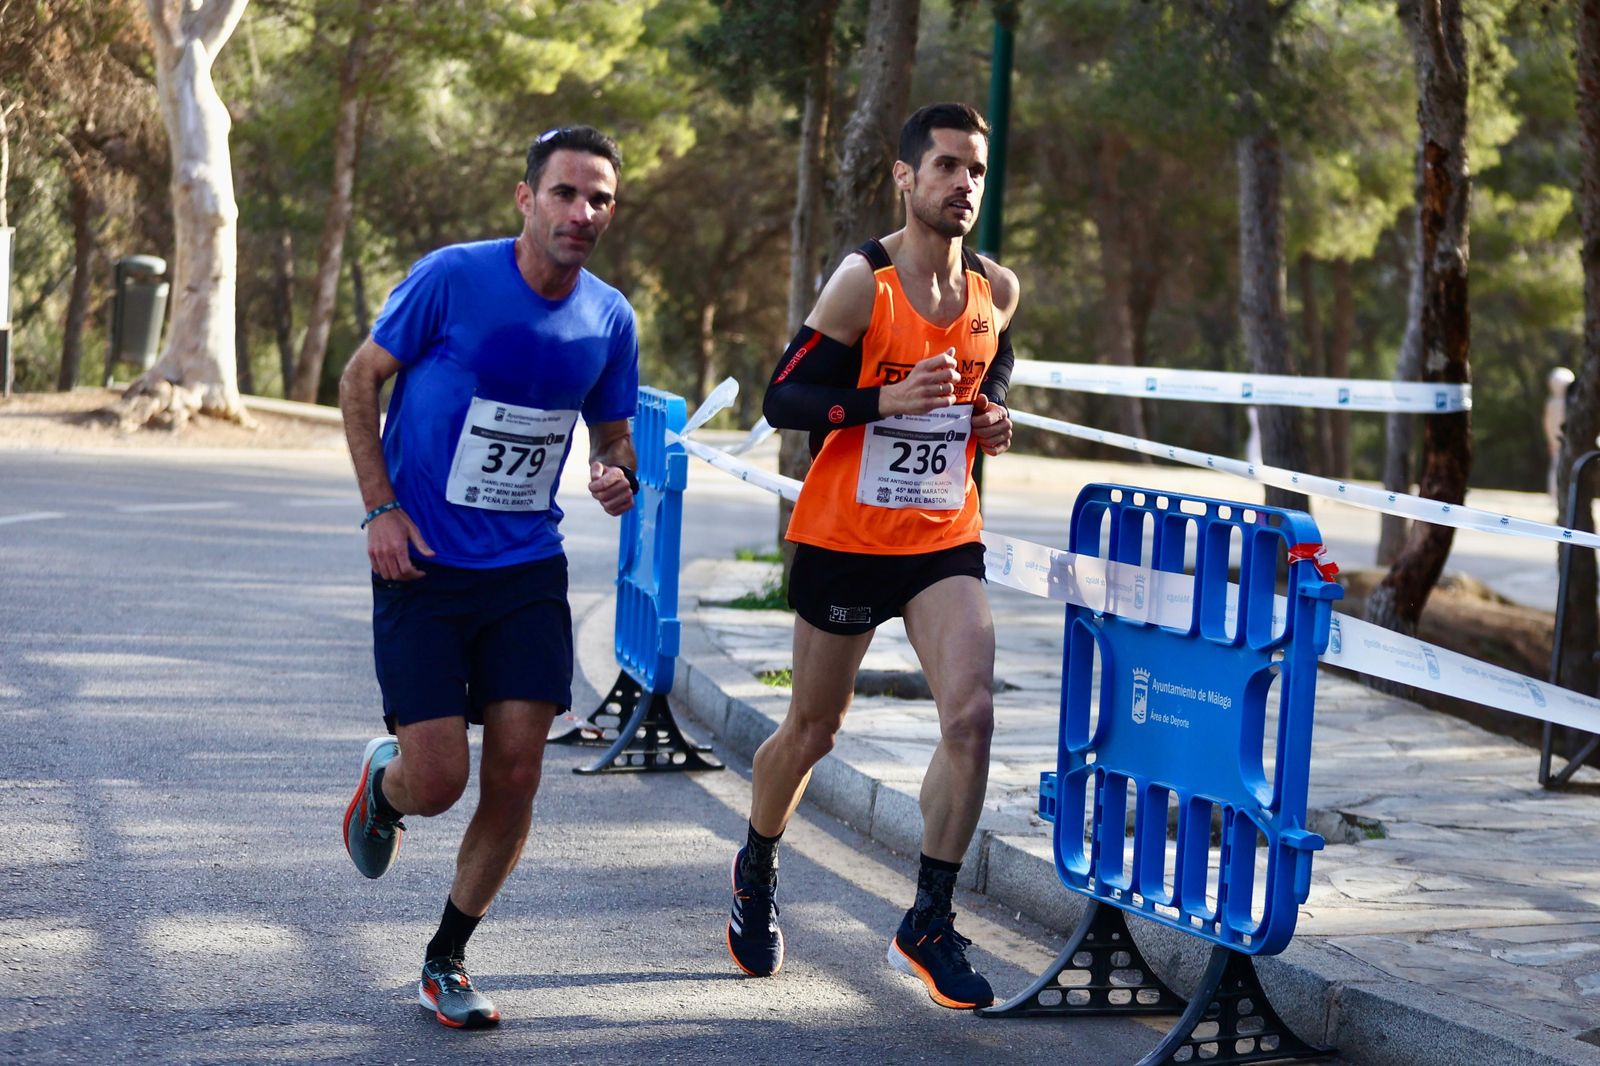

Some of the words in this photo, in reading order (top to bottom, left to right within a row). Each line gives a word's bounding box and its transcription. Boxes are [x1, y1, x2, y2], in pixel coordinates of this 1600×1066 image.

[481, 442, 546, 478] 379
[889, 441, 947, 475] 236
[481, 478, 499, 487] DANIEL
[890, 478, 913, 486] ANTONIO
[482, 495, 501, 504] PEÑA
[894, 495, 913, 503] PEÑA
[832, 608, 848, 621] PH
[1152, 678, 1197, 700] Ayuntamiento
[1197, 689, 1207, 702] de
[1207, 690, 1232, 710] Málaga
[1162, 714, 1170, 724] de
[1170, 714, 1190, 729] Deporte
